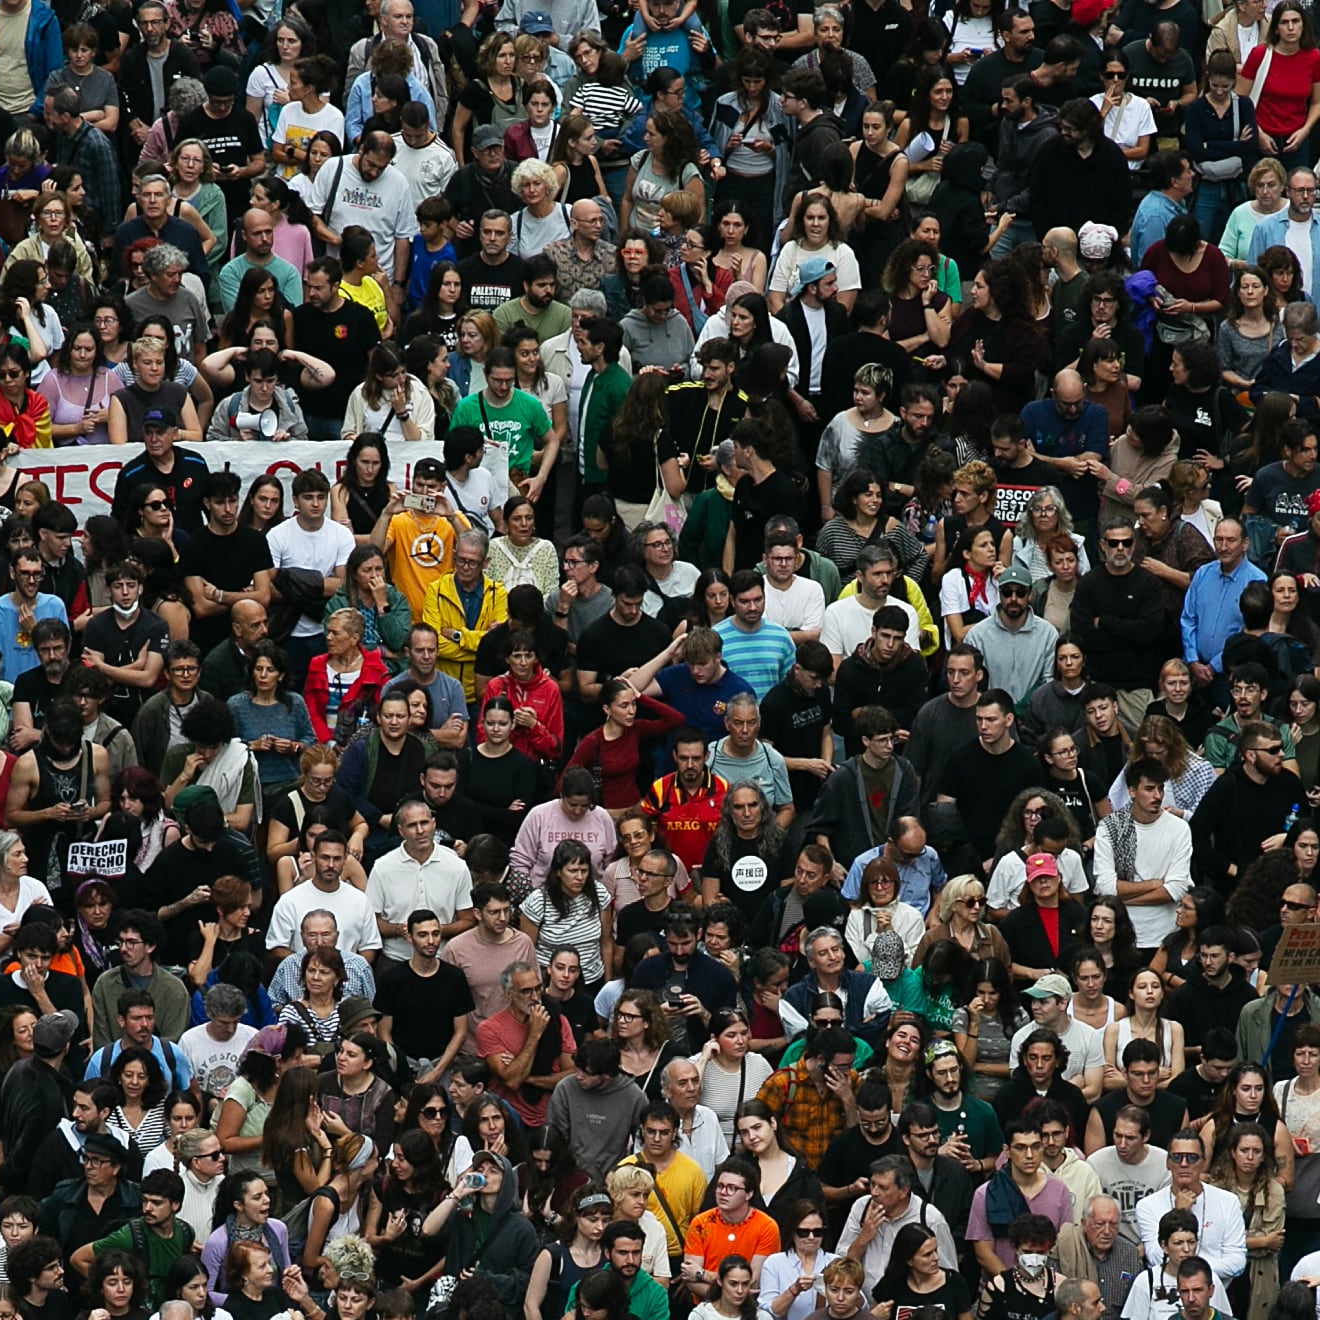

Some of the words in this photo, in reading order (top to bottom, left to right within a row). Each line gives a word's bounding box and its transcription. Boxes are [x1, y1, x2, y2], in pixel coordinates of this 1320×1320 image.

[471, 286, 511, 298] PALESTINA
[471, 296, 510, 306] INSUMIS
[666, 820, 717, 832] ARAGN
[548, 831, 599, 843] BERKELEY
[71, 843, 125, 857] DERECHO
[70, 855, 78, 866] A
[83, 855, 123, 868] TECHO
